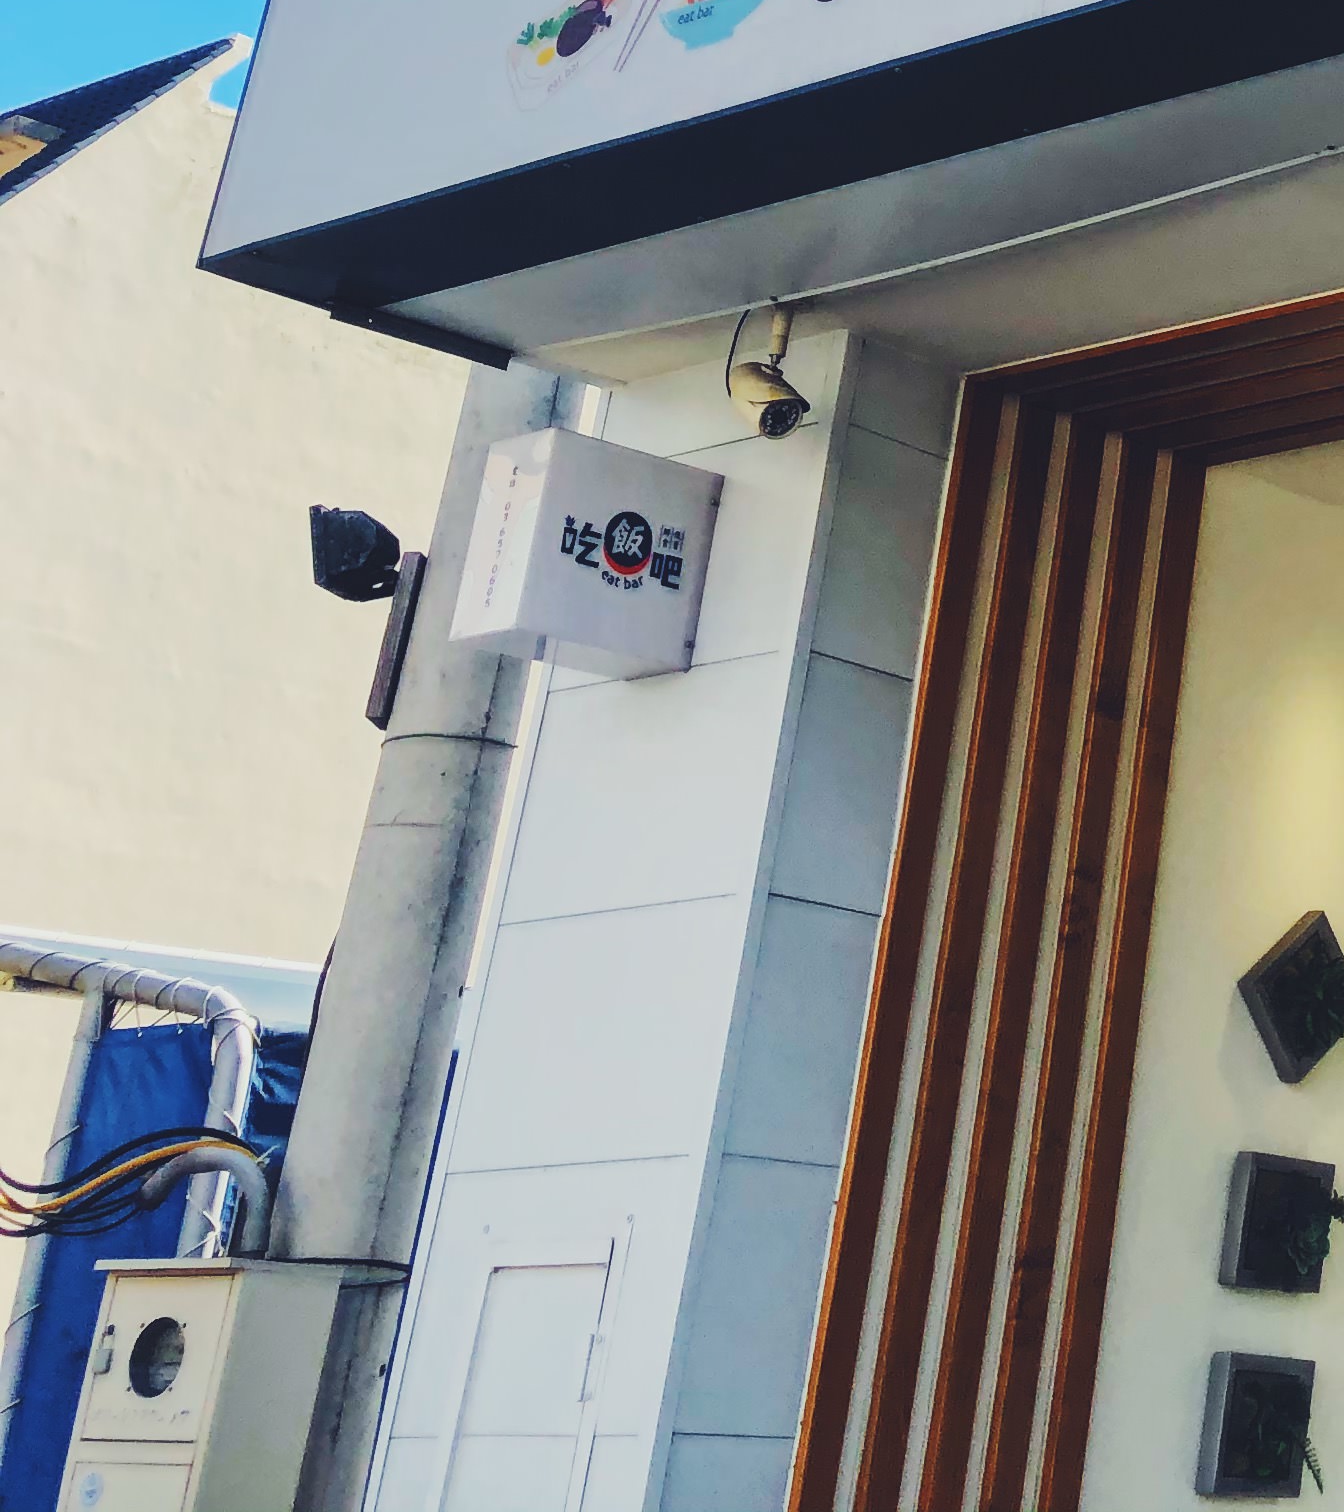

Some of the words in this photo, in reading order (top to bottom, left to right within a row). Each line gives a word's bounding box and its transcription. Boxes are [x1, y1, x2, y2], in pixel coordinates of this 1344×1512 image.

[677, 7, 695, 25] eat
[697, 4, 715, 21] bar
[601, 570, 621, 588] eat
[623, 575, 644, 590] bar
